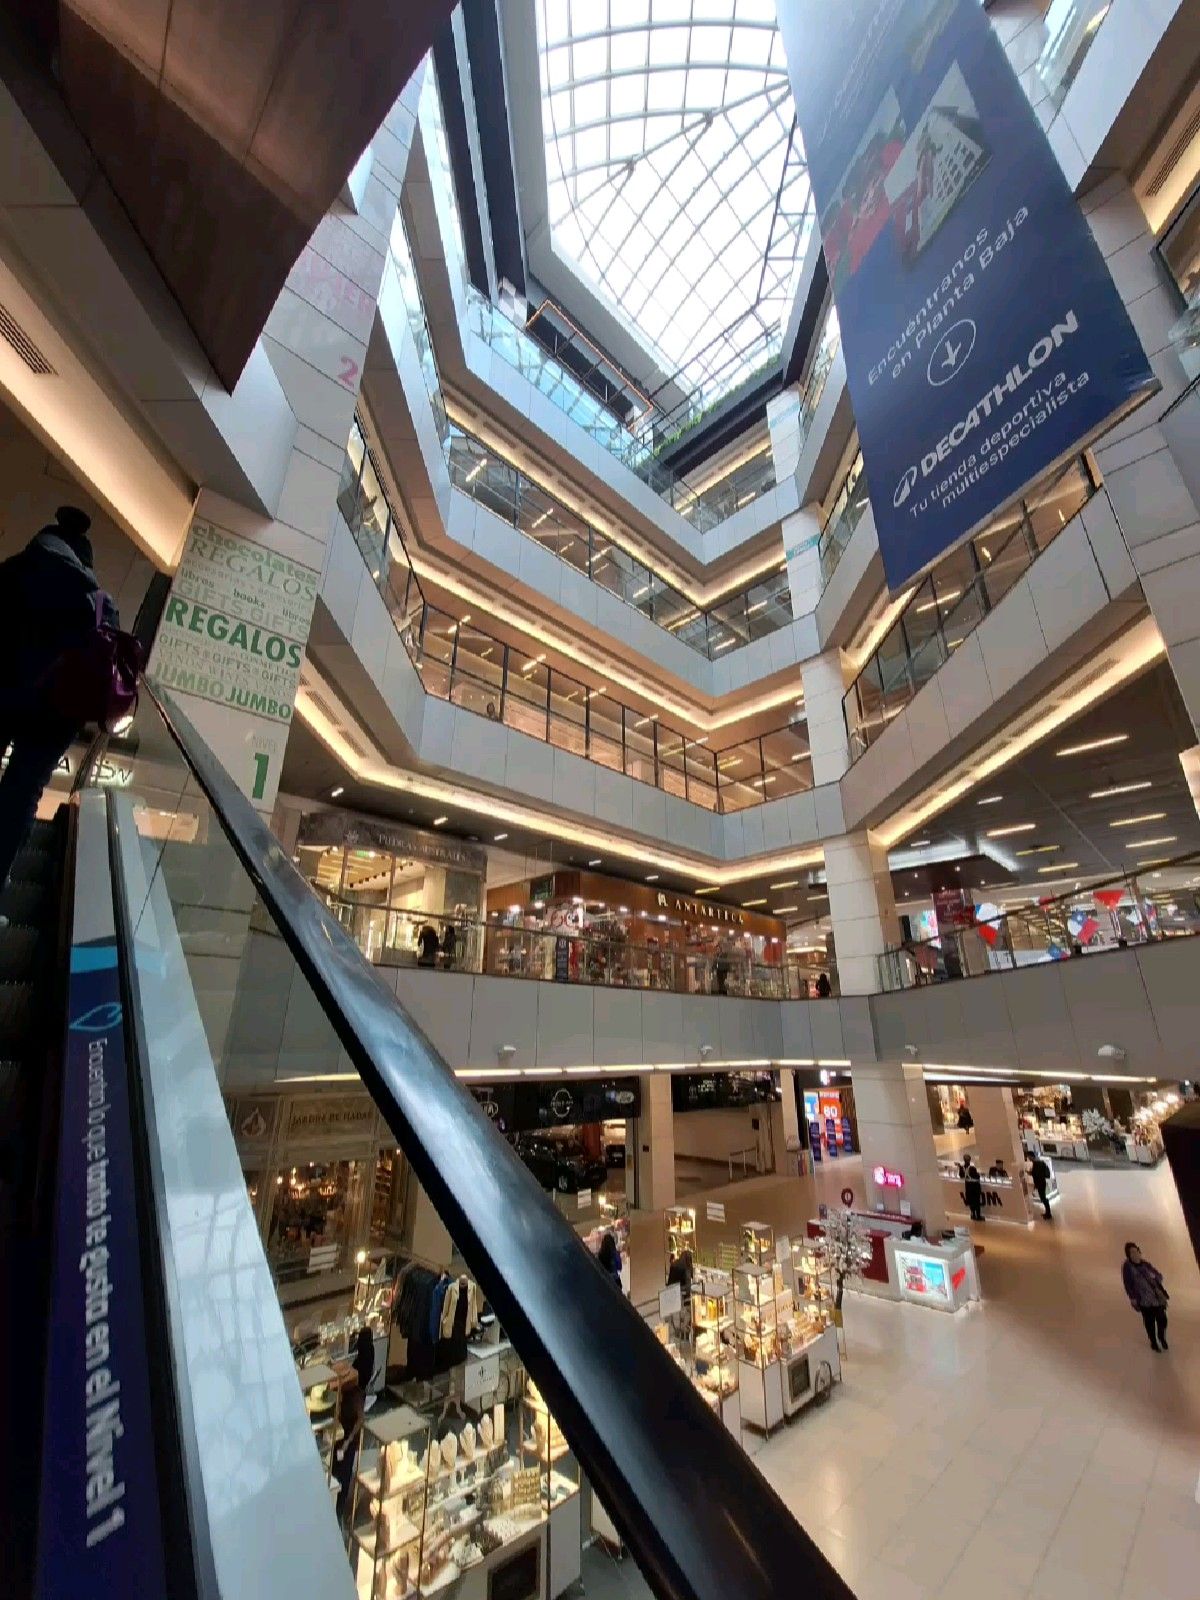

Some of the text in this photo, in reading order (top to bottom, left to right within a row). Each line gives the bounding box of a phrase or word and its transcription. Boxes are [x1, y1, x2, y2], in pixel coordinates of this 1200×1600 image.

[868, 227, 988, 386] Encuéntranos
[892, 351, 912, 379] en
[979, 206, 1029, 270] Baja
[338, 356, 359, 390] 2
[921, 309, 1079, 478] DECATHLON
[910, 372, 1066, 519] Tu tienda deportiva
[942, 371, 1090, 509] multiespecialista
[188, 538, 315, 602] REGALOS
[191, 524, 318, 586] chocolates
[233, 587, 266, 609] books
[159, 633, 203, 657] GIFTS
[212, 652, 252, 674] GIFTS
[164, 597, 302, 669] REGALOS
[154, 662, 225, 698] JUMBO
[225, 686, 292, 720] JUMBO
[252, 752, 270, 800] 1
[81, 1123, 107, 1162] que
[85, 1213, 111, 1247] te
[80, 1243, 113, 1325] gusta
[85, 1320, 110, 1371] en
[86, 1367, 120, 1408] el
[86, 1396, 125, 1519] Nivel
[86, 1505, 126, 1548] 1
